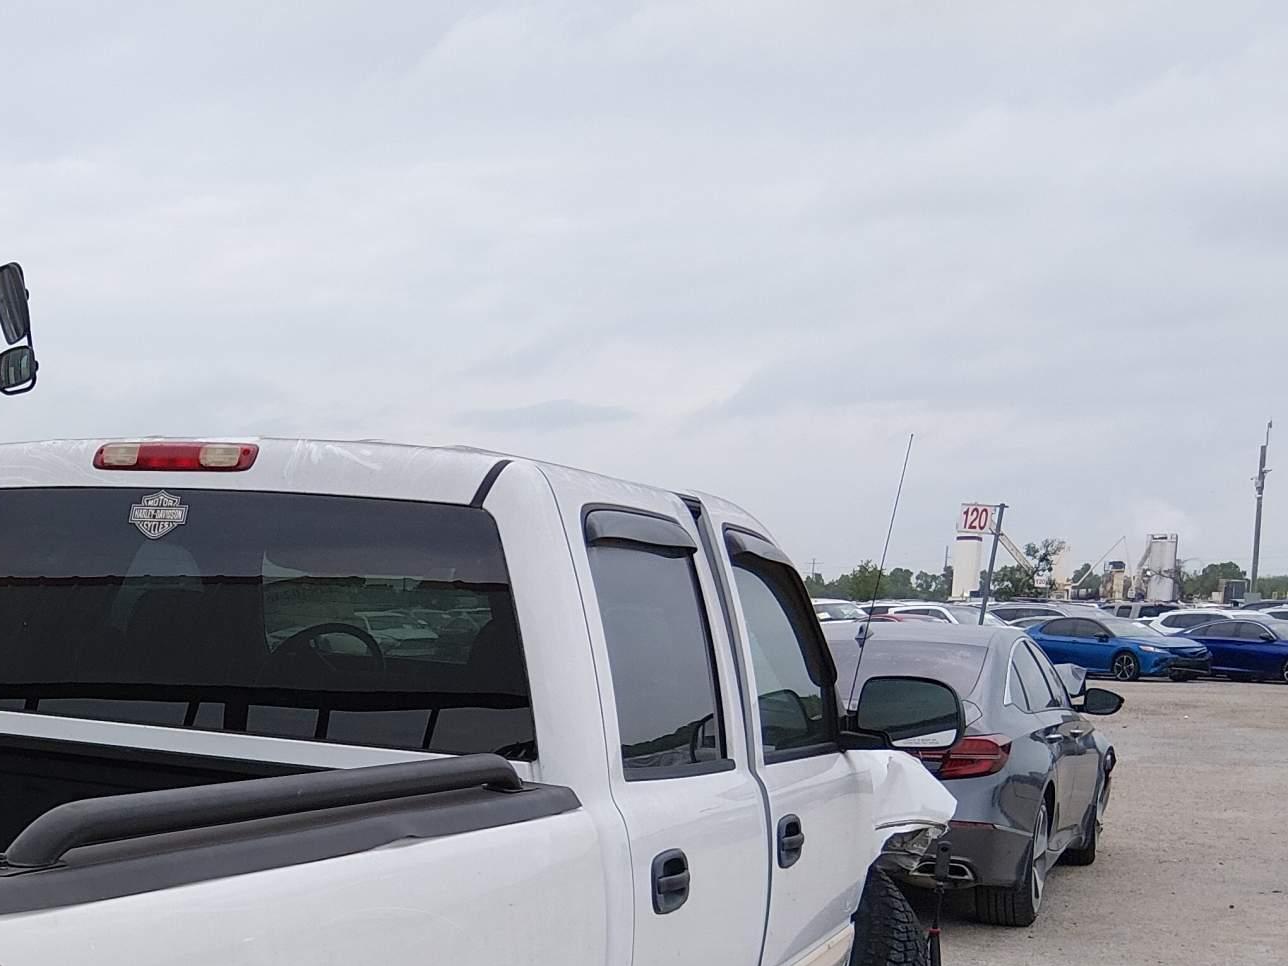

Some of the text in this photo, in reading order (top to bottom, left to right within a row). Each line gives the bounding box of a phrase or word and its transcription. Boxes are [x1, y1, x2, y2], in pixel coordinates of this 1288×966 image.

[147, 499, 174, 507] MOTOR
[134, 509, 183, 519] HARLEY-DAVIDSON
[963, 507, 989, 531] 120
[143, 521, 170, 534] CYCLES
